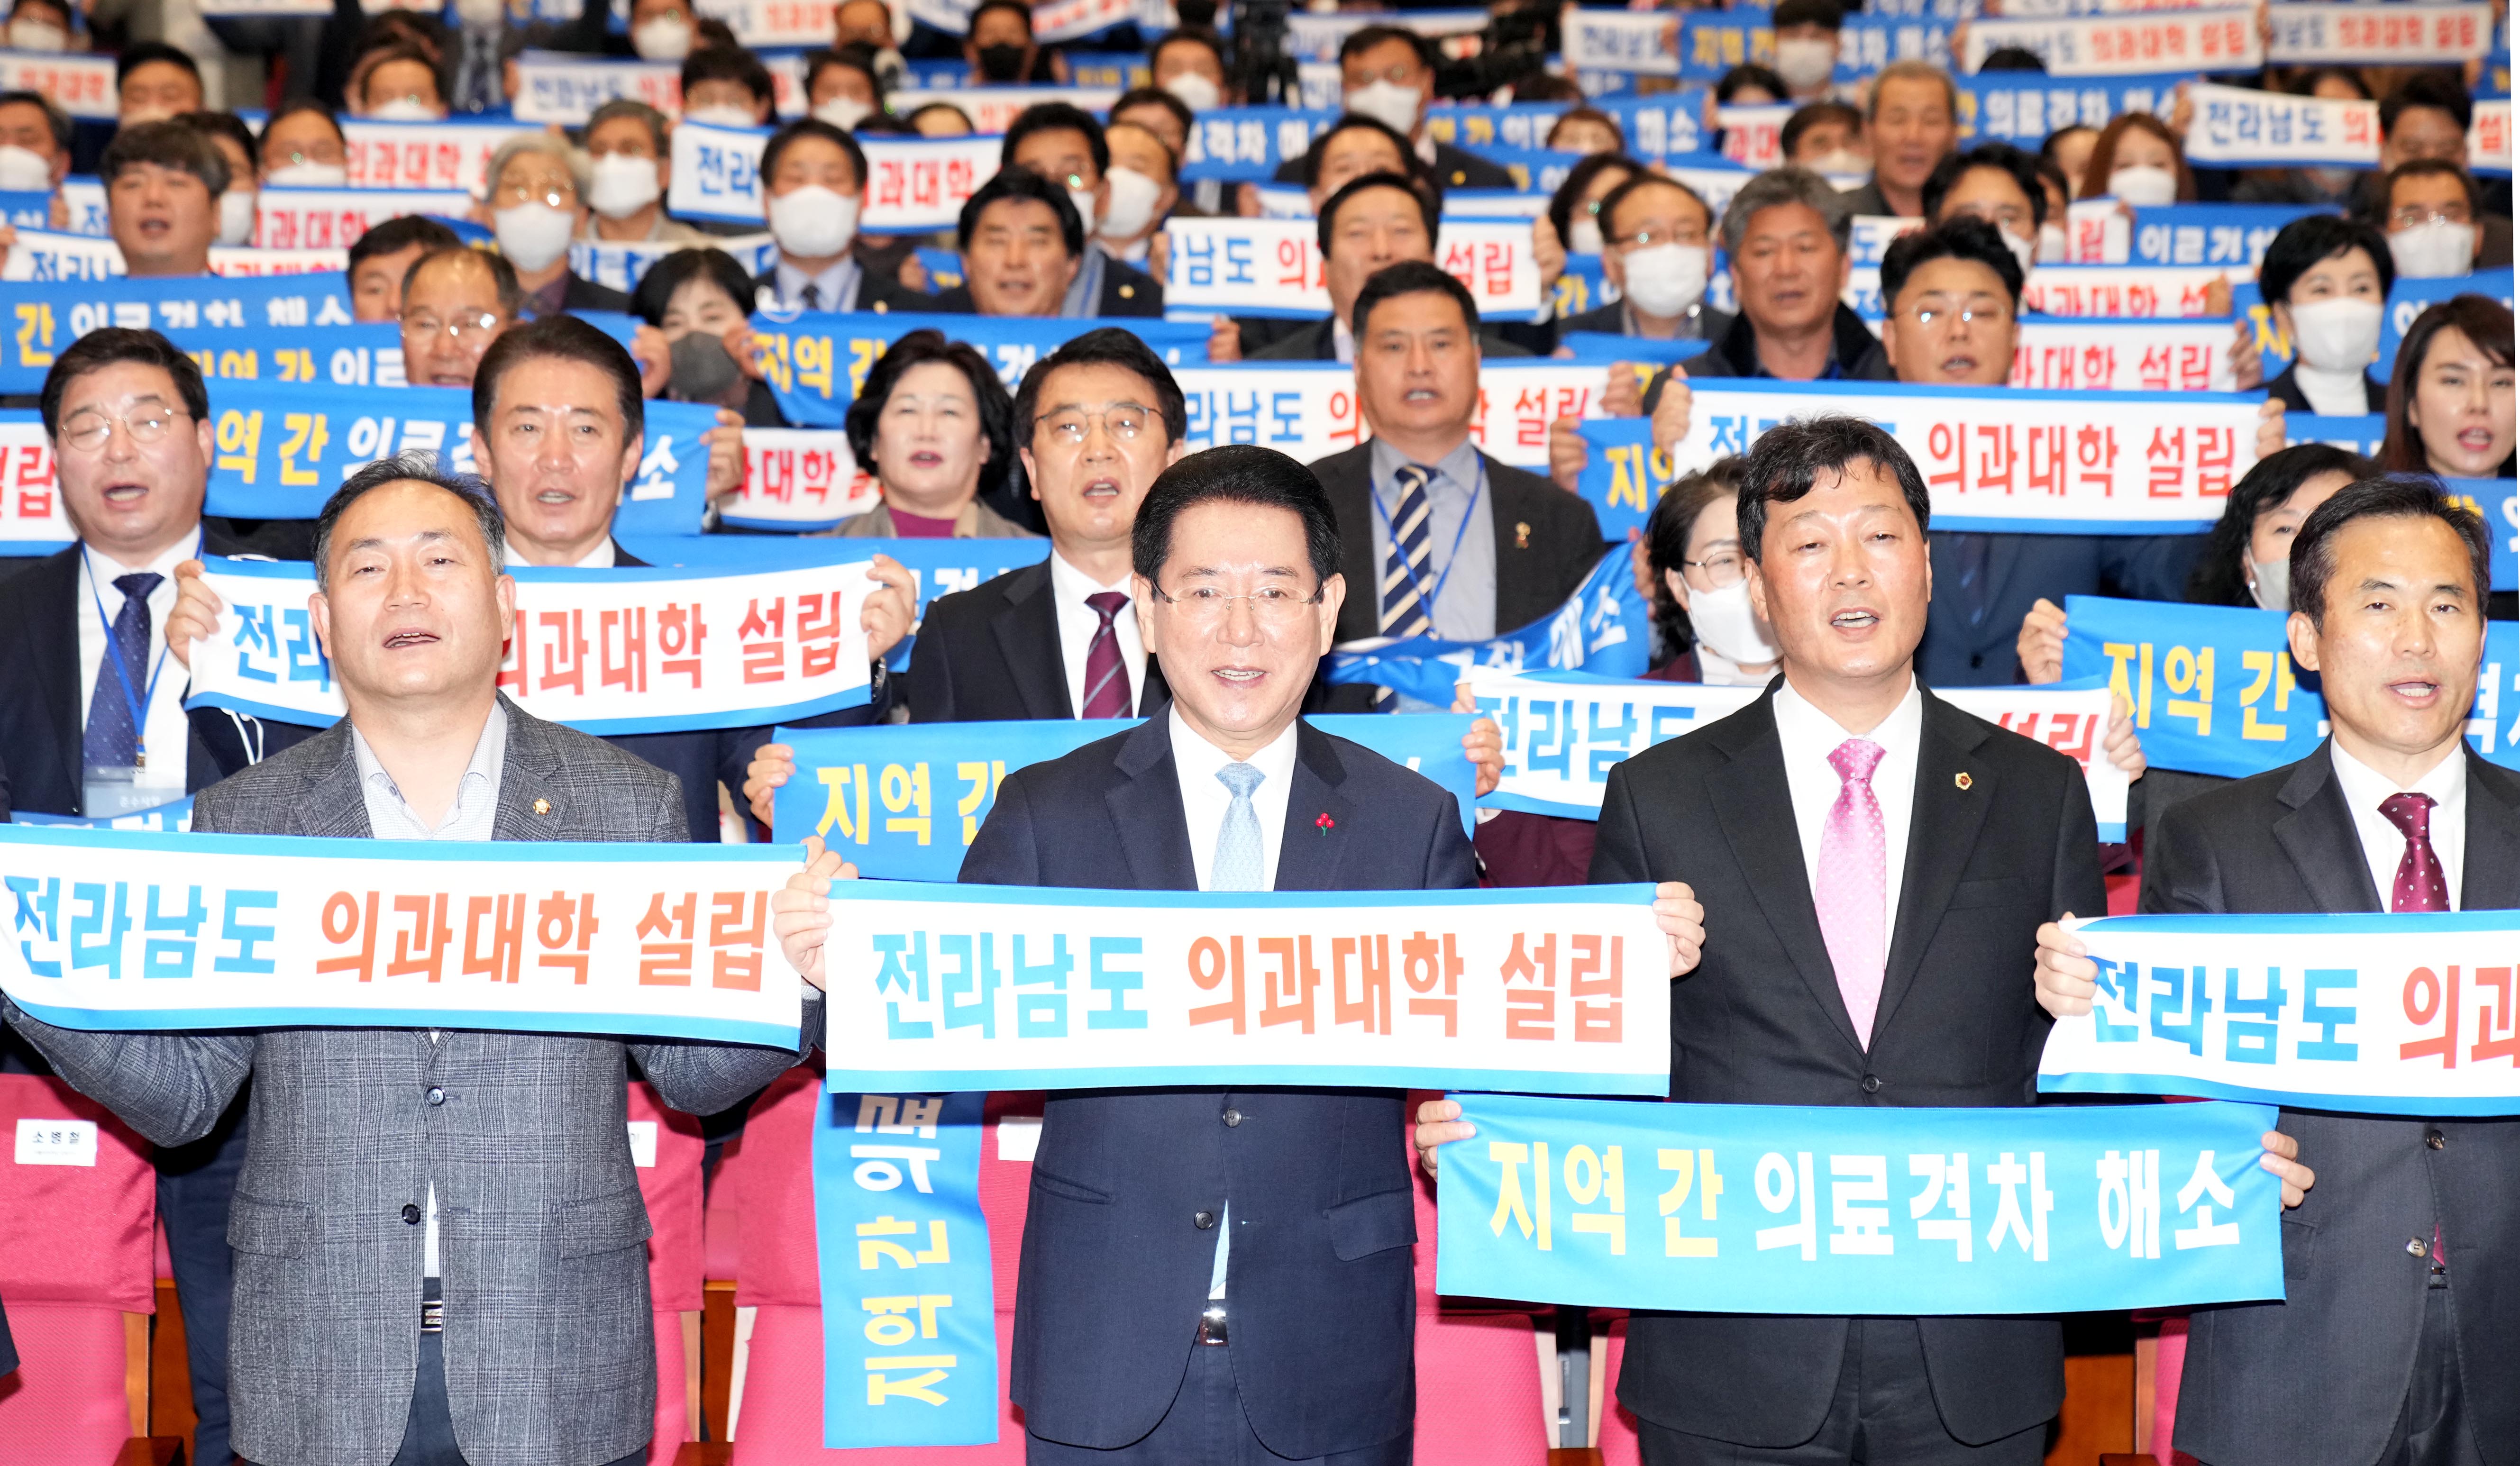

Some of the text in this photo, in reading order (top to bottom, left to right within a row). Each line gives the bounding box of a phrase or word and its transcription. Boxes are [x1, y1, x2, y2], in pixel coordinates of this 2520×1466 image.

[2208, 101, 2326, 147] 전라남도
[863, 159, 975, 208] 과대학
[1167, 234, 1255, 286] 남도
[15, 303, 56, 367] 간
[216, 409, 264, 484] 역
[279, 413, 329, 486] 간
[1185, 391, 1303, 446] 라남도
[0, 445, 57, 519] 립
[741, 446, 836, 505] 대학
[1928, 421, 2119, 499] 의과대학
[2146, 425, 2236, 499] 설립
[233, 604, 330, 693] 전라
[738, 590, 842, 685] 설립
[2103, 641, 2296, 742] 지역 간
[815, 761, 932, 846] 지역
[4, 874, 767, 993] 전라남도 의과대학 설립
[871, 930, 1625, 1044] 전라남도 의과대학 설립
[2093, 955, 2519, 1070] 전라남도 의과
[1488, 1140, 2241, 1263] 지역 간 의료격차 해소
[850, 1094, 958, 1408] 지역 간 의료
